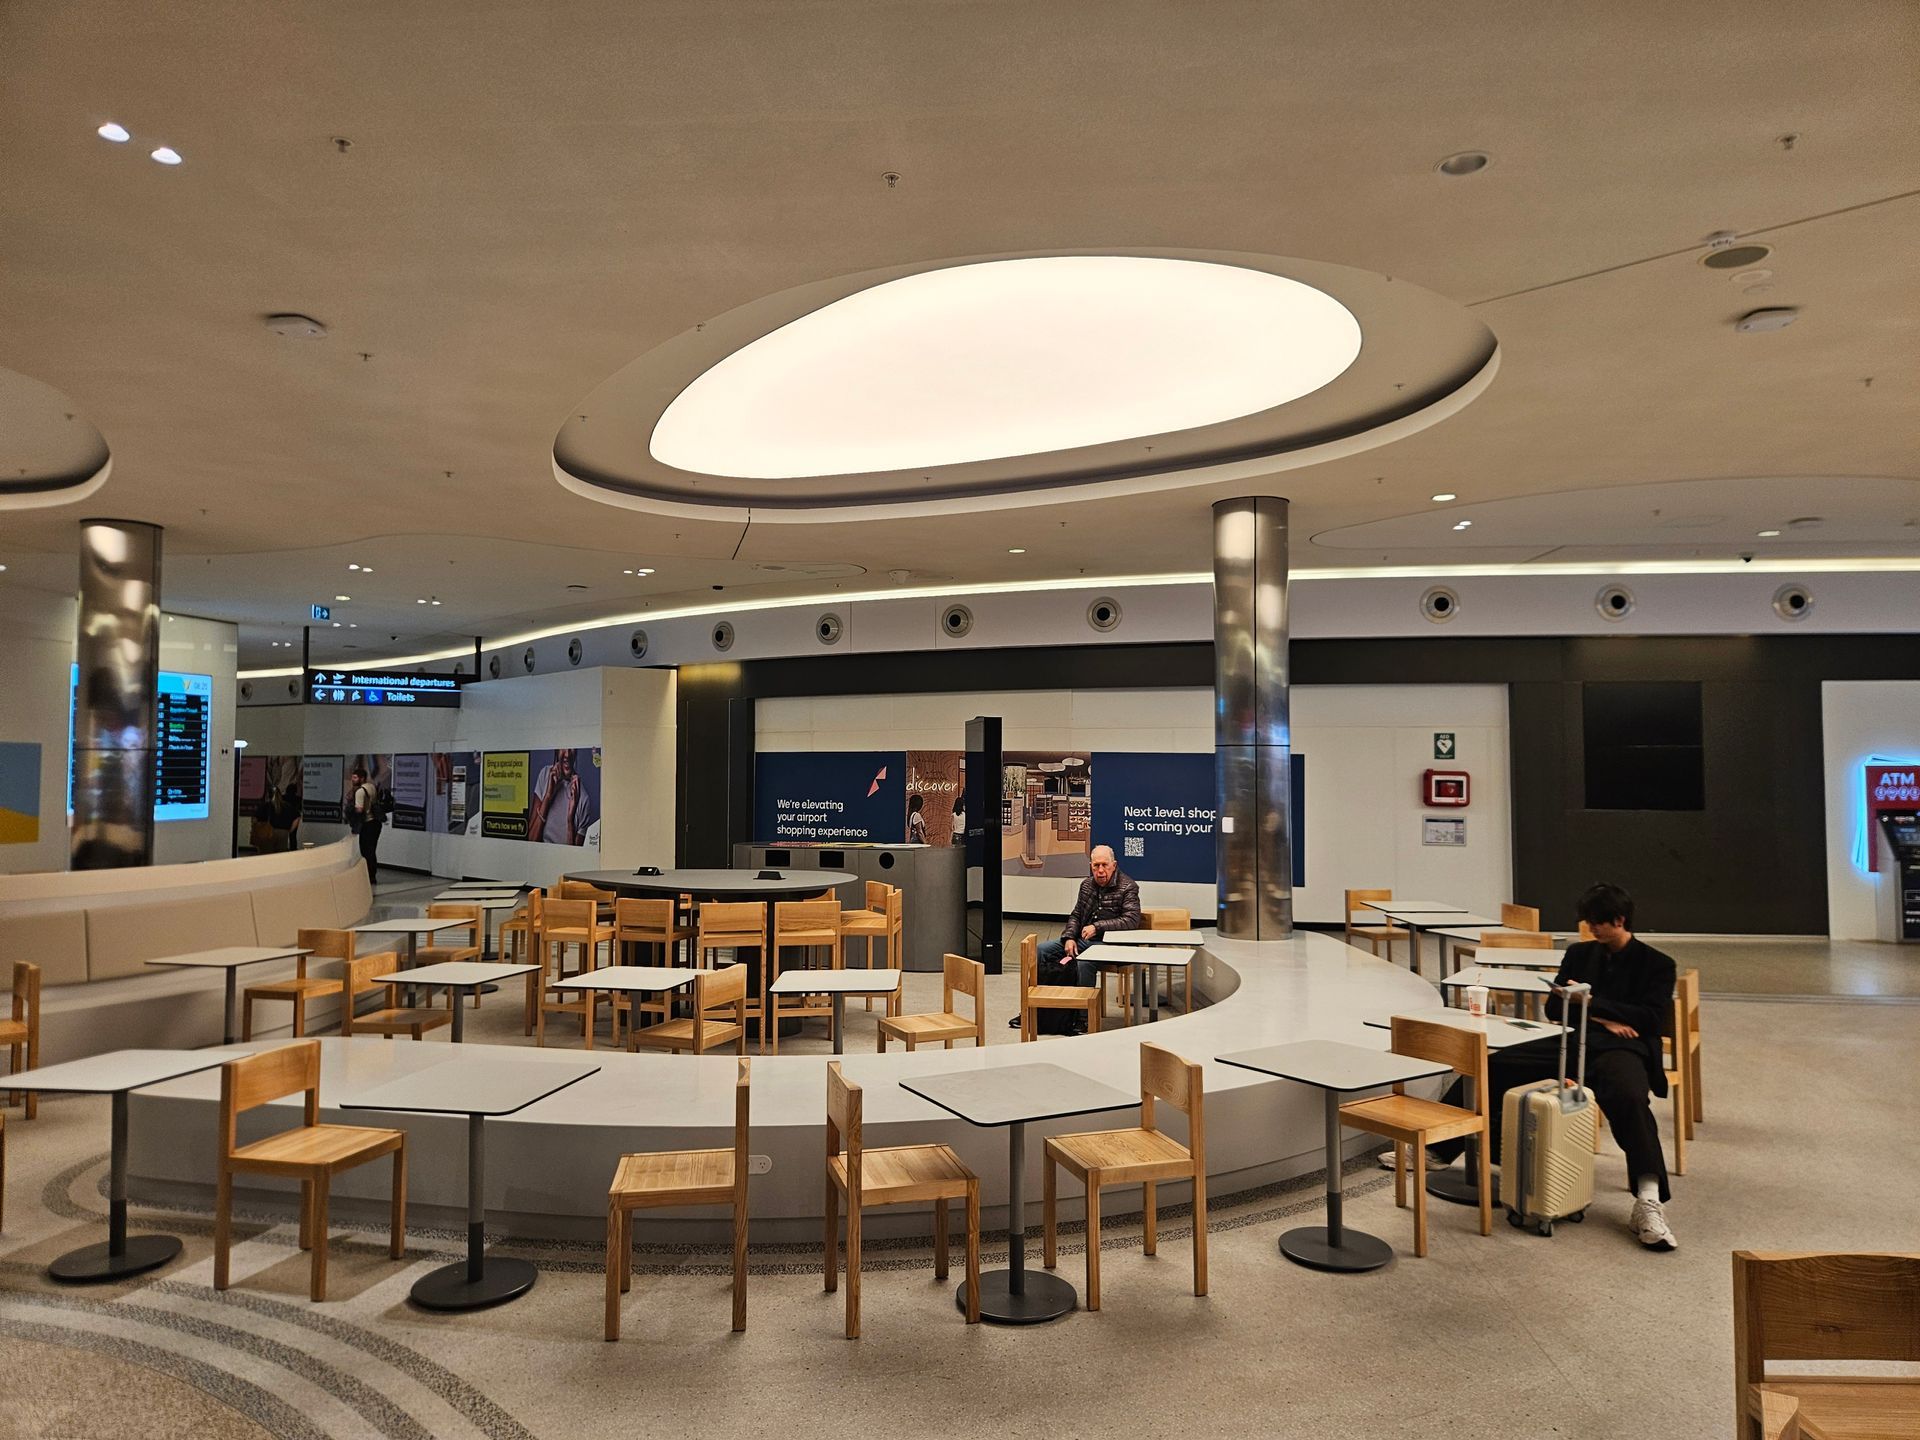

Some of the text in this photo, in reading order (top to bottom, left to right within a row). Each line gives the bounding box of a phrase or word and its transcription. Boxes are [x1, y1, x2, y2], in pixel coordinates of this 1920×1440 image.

[352, 674, 456, 688] International departures
[387, 692, 416, 702] Toilets
[906, 767, 958, 792] discover
[1881, 772, 1915, 786] ATM
[777, 799, 844, 813] We're elevating
[1124, 806, 1152, 817] Next
[1154, 806, 1186, 818] level
[777, 812, 827, 824] your airport
[501, 821, 510, 830] how
[517, 822, 525, 833] fly
[777, 825, 868, 838] shopping experience
[1124, 820, 1214, 835] is coming your
